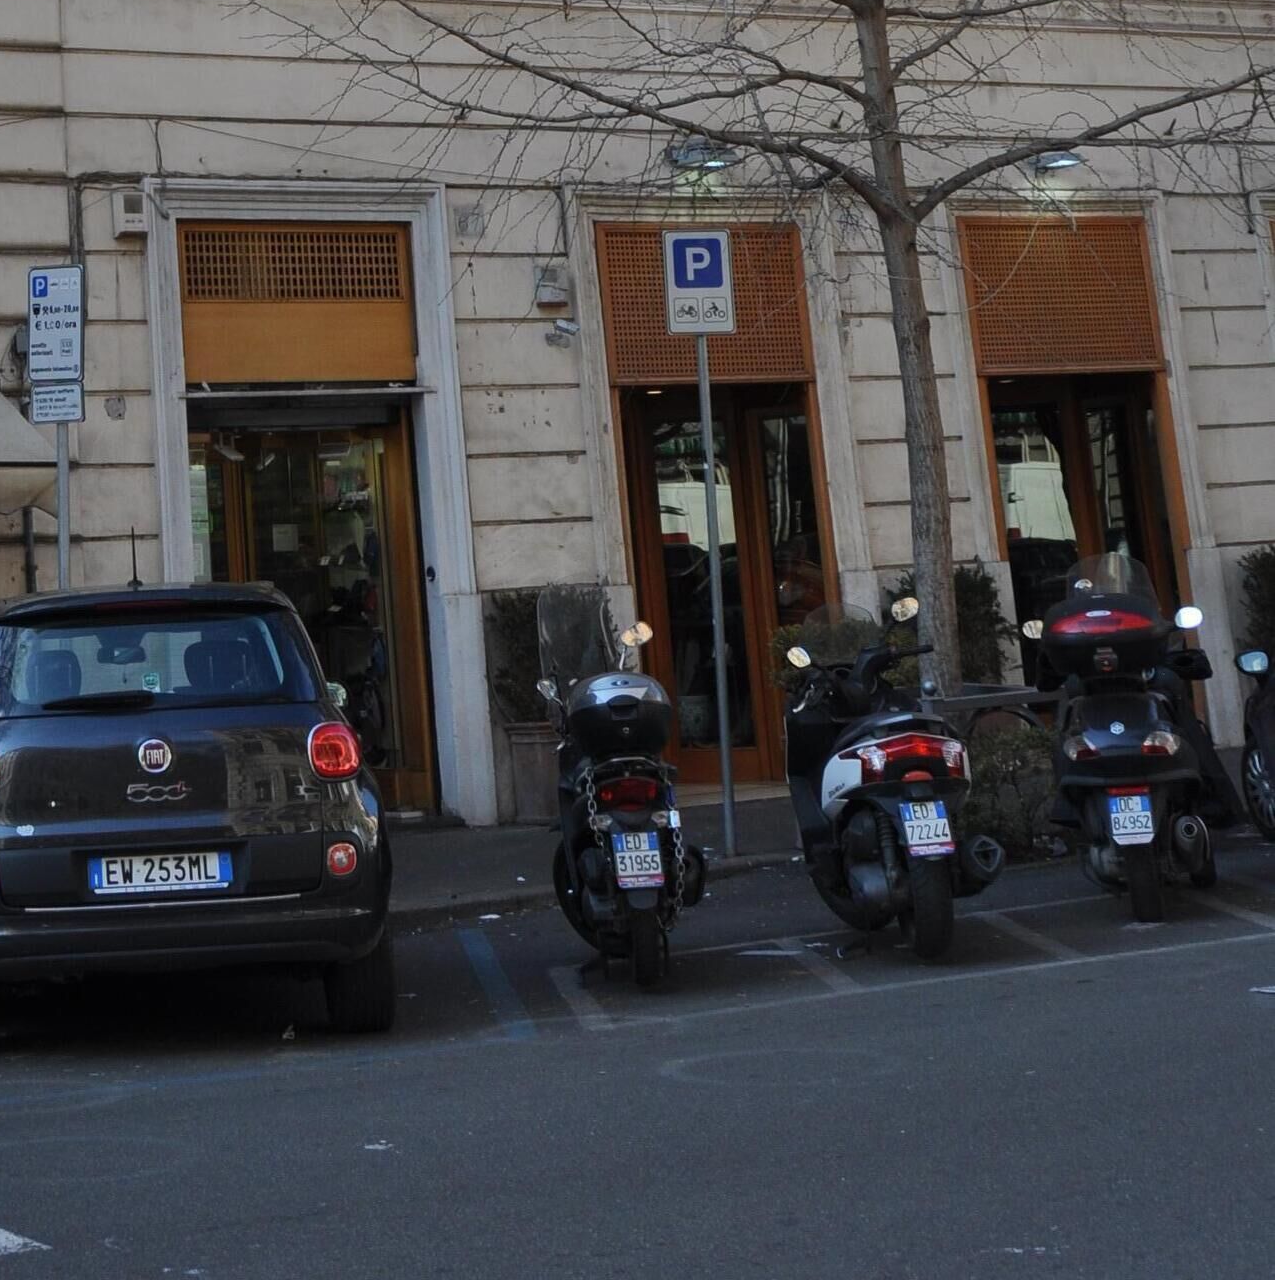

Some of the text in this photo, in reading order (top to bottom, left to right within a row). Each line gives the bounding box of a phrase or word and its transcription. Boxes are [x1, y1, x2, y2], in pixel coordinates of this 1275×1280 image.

[685, 247, 711, 281] P
[35, 278, 45, 296] P
[145, 749, 165, 765] FIAT
[907, 822, 949, 841] 72244
[1113, 815, 1151, 831] 84952
[106, 855, 216, 885] EW 253ML
[618, 854, 660, 872] 31955
